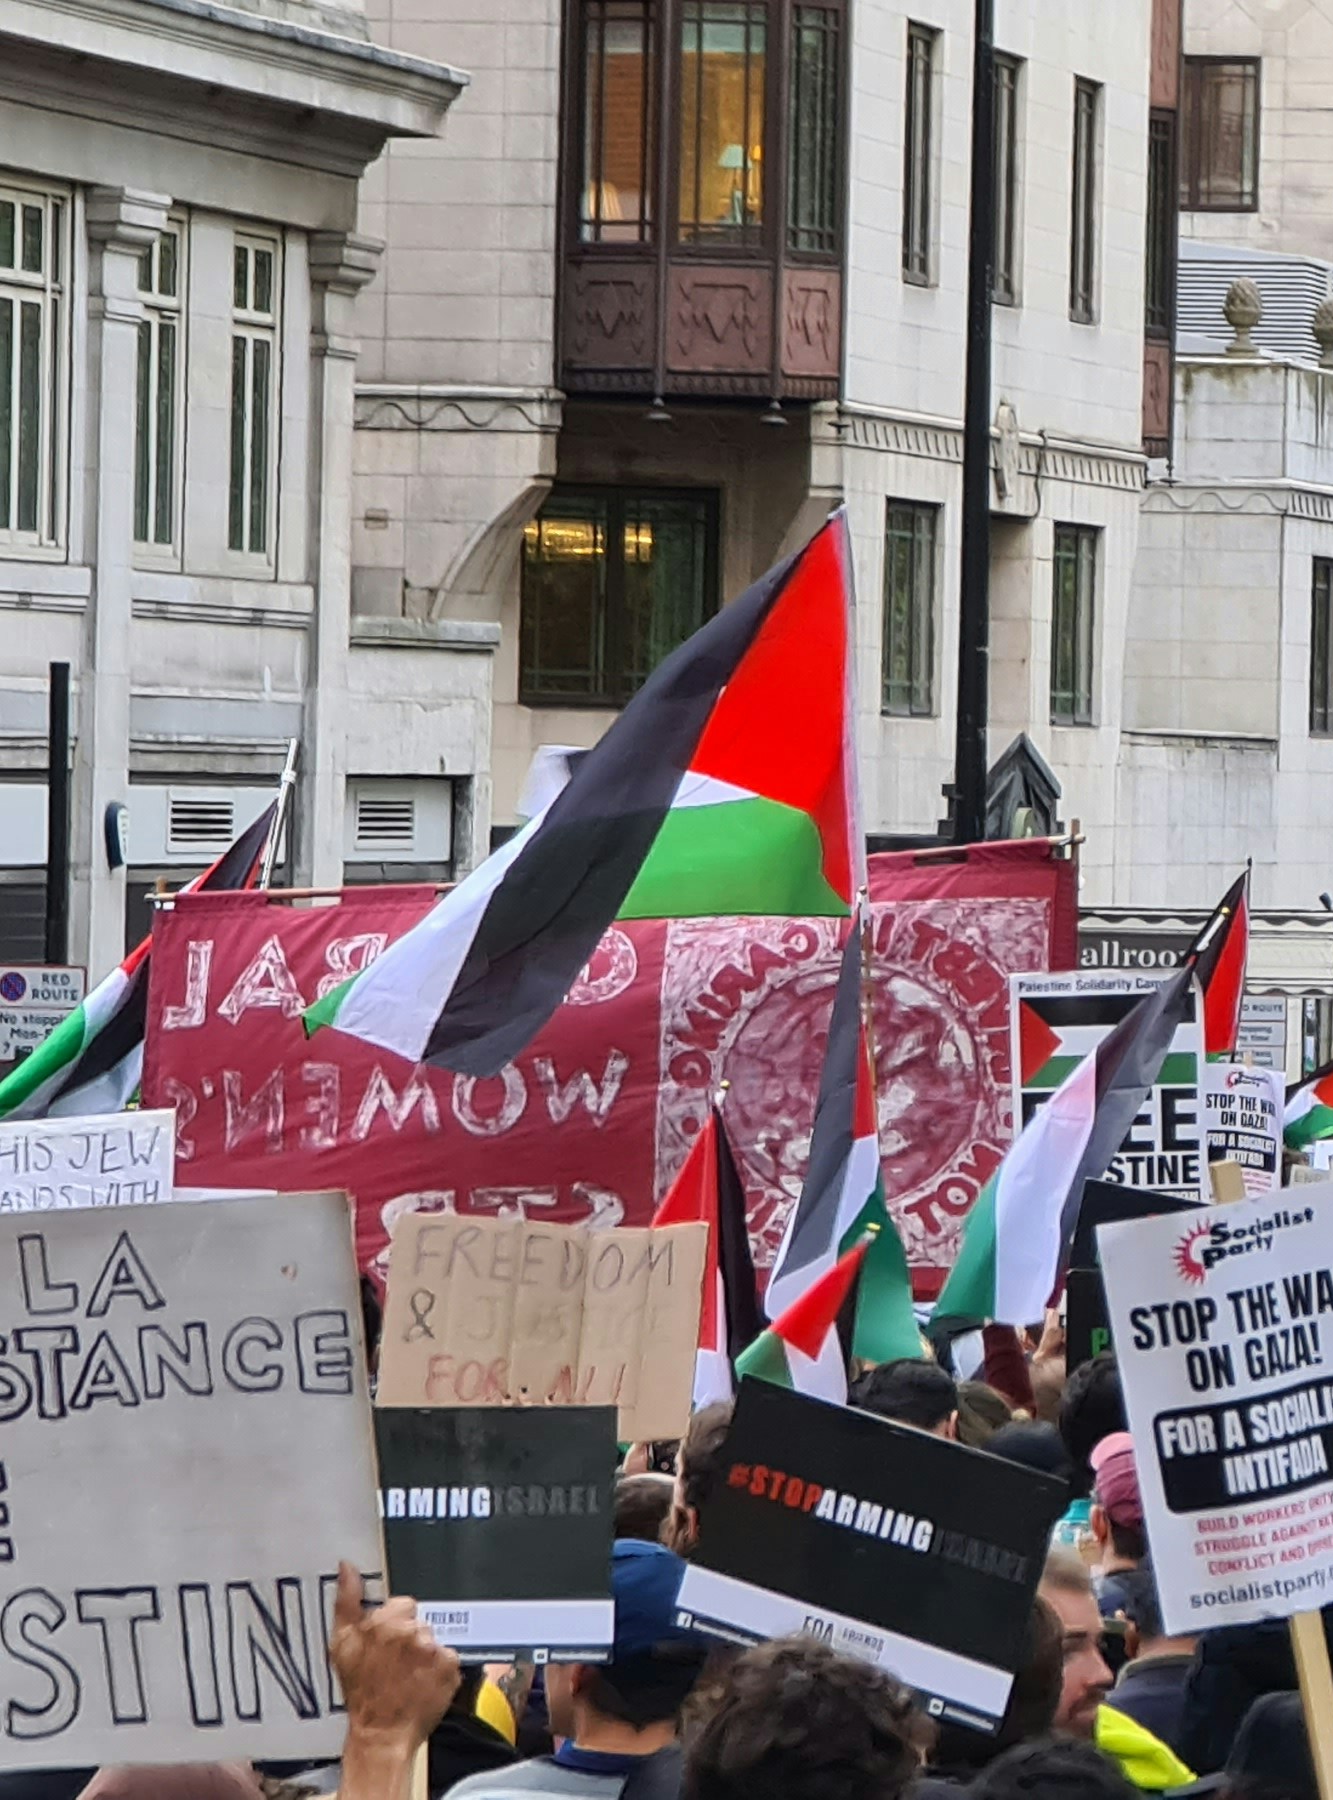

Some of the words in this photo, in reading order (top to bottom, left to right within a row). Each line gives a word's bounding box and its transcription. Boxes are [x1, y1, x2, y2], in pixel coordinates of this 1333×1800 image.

[1080, 940, 1184, 967] allroo
[32, 989, 79, 1001] ROUTE
[42, 973, 70, 985] RED
[1018, 980, 1072, 993] Palestine
[1076, 978, 1131, 993] Solidarity
[1206, 1093, 1236, 1109] STOP
[1239, 1095, 1257, 1112] THE
[69, 1126, 160, 1174] JEW
[1209, 1207, 1314, 1246] Socialist
[18, 1231, 167, 1318] LA
[413, 1224, 675, 1293] FREEDOM
[1202, 1234, 1273, 1269] Party
[402, 1287, 436, 1343] &
[1130, 1297, 1218, 1351] STOP
[1226, 1282, 1282, 1335] THE
[424, 1353, 507, 1403] FOR
[1185, 1344, 1236, 1392] ON
[1245, 1321, 1324, 1382] GAZA!
[1159, 1414, 1218, 1459] FOR
[1223, 1409, 1247, 1450] A
[1223, 1433, 1329, 1497] INTIFADA
[1280, 1545, 1305, 1562] AND
